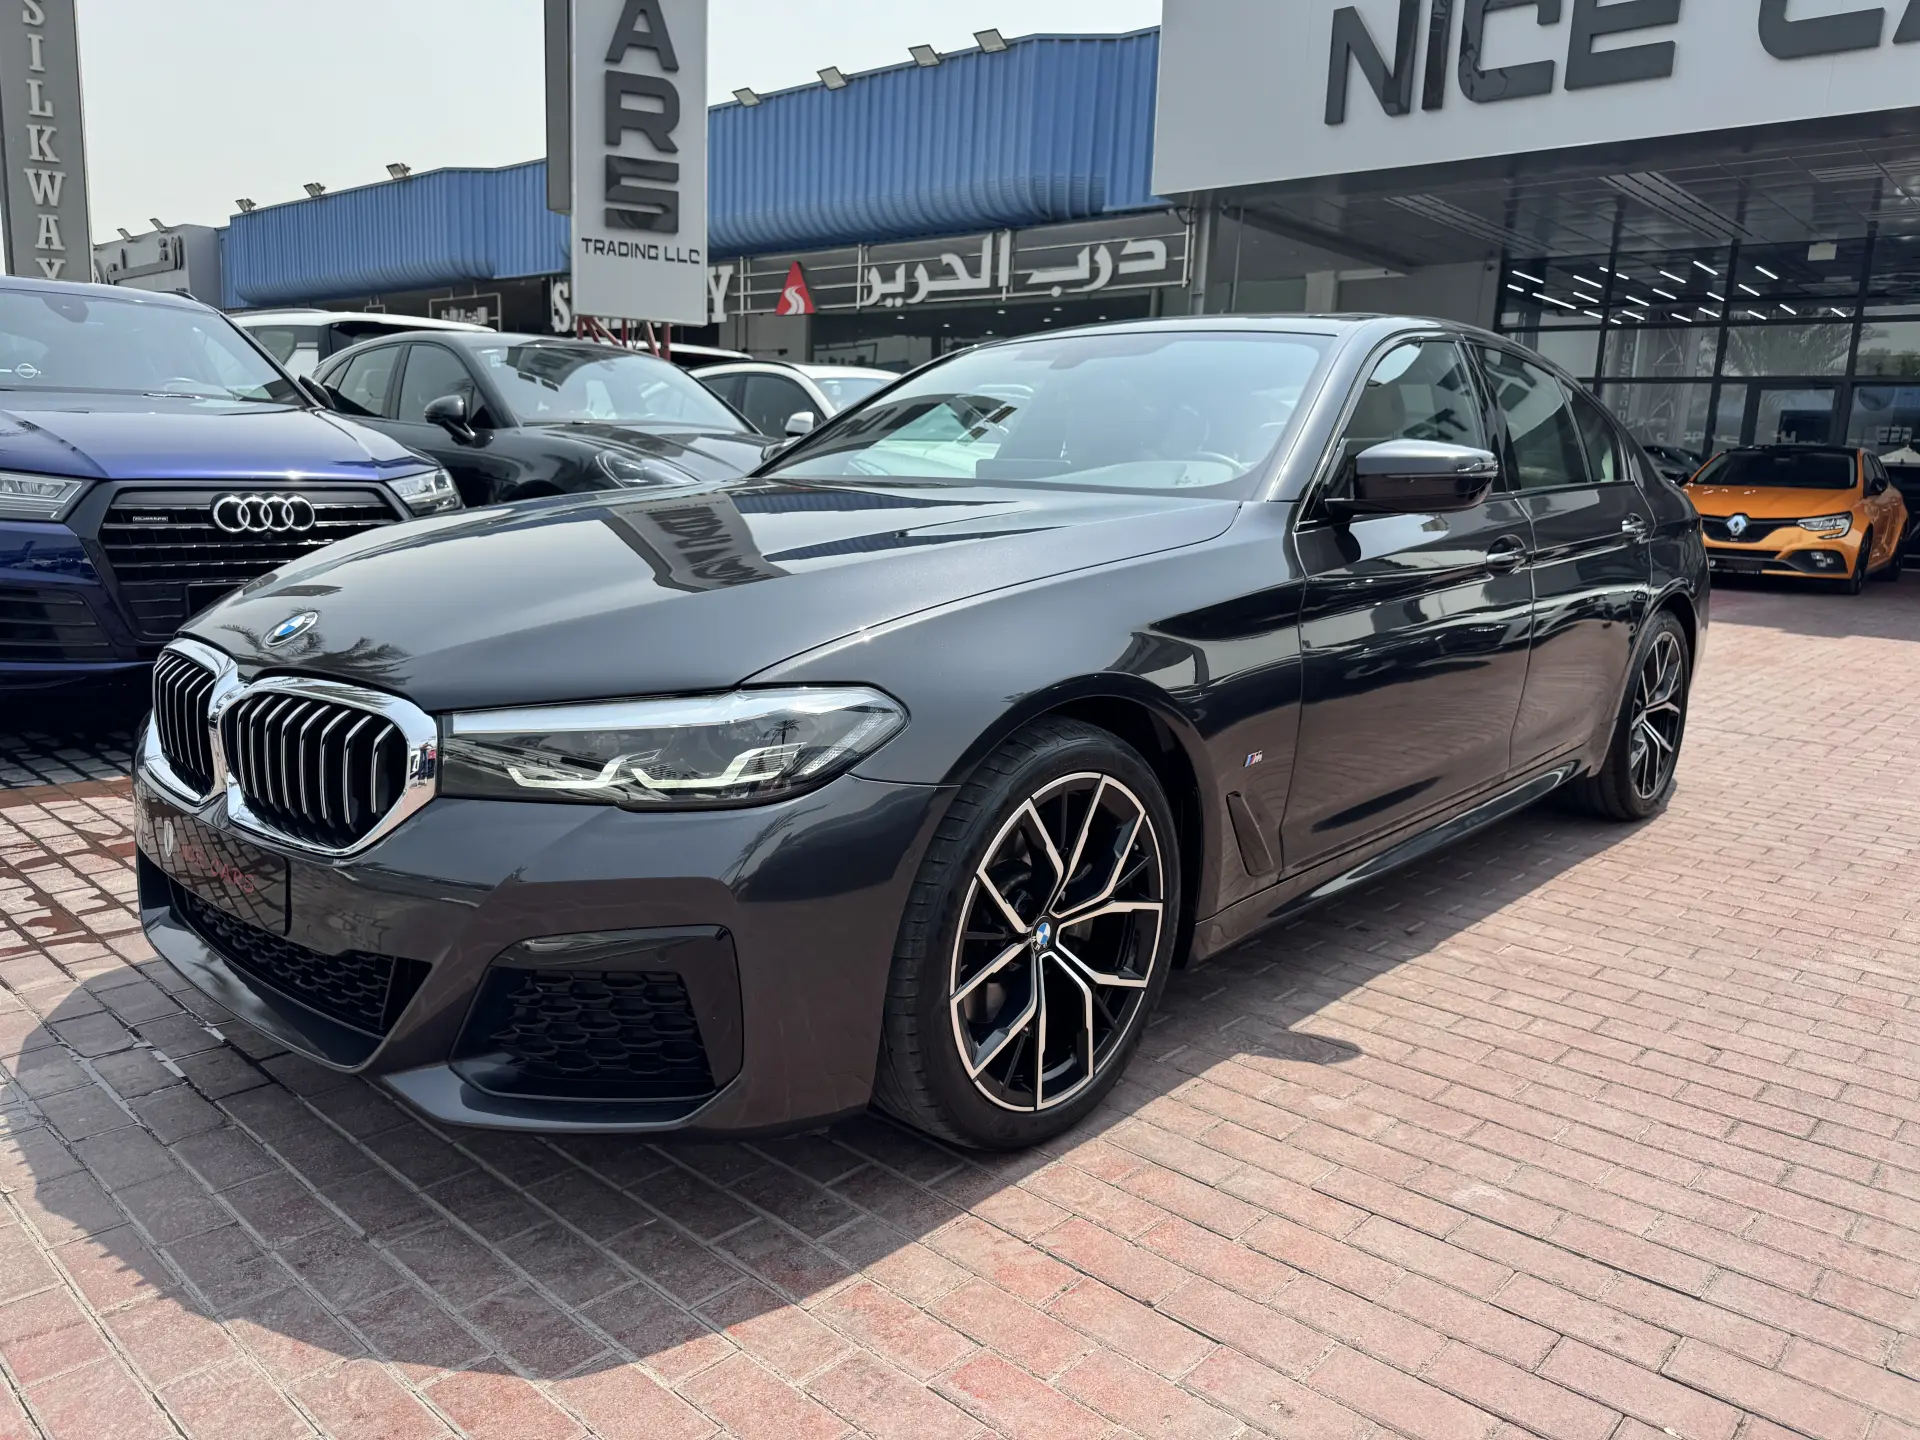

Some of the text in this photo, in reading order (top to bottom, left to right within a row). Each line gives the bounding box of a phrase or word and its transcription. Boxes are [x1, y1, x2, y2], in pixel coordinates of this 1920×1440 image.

[1325, 0, 1680, 125] NICE
[22, 0, 67, 280] SILKWAY
[581, 237, 701, 265] TRADING LLC
[861, 229, 1168, 308] درب الحرير
